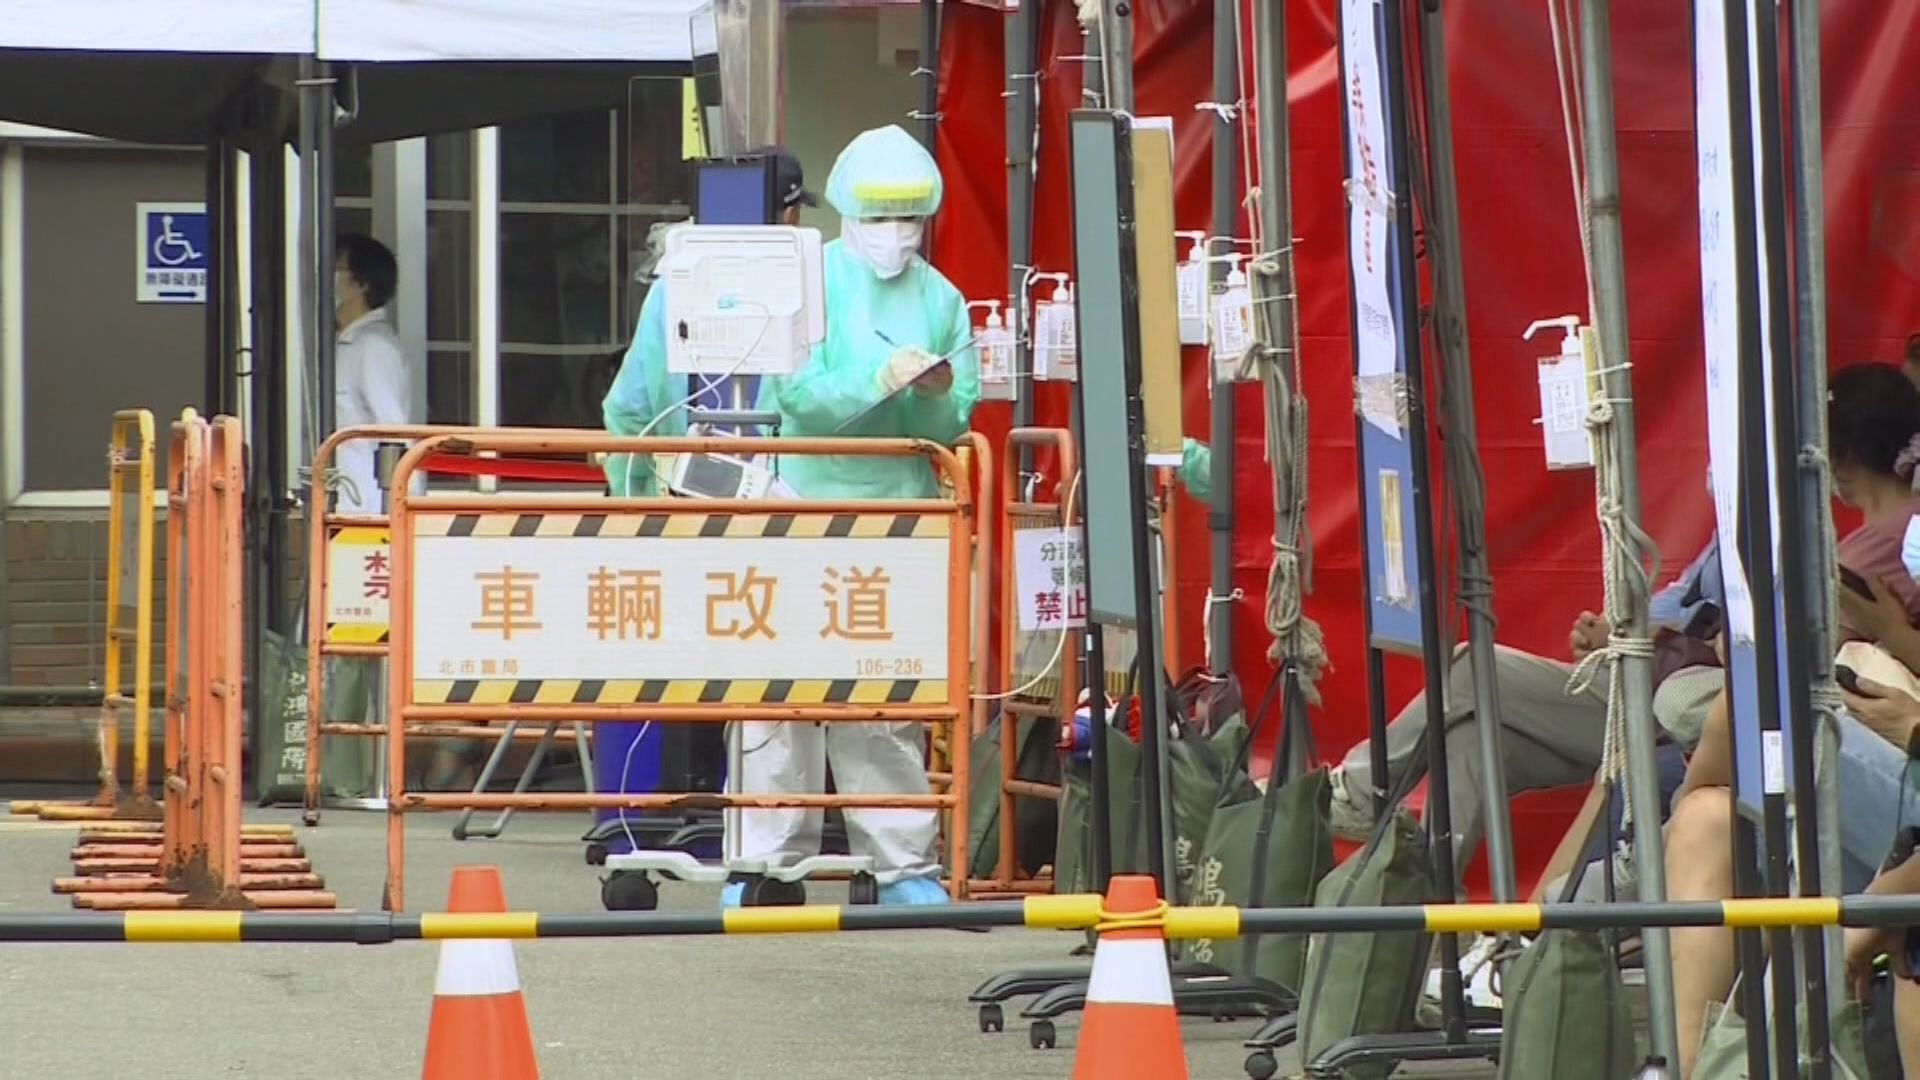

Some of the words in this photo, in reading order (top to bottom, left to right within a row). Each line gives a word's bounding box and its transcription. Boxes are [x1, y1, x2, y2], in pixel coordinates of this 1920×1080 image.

[471, 565, 894, 641] 車輛改道
[1035, 588, 1087, 622] 禁止
[855, 657, 922, 676] 106-236
